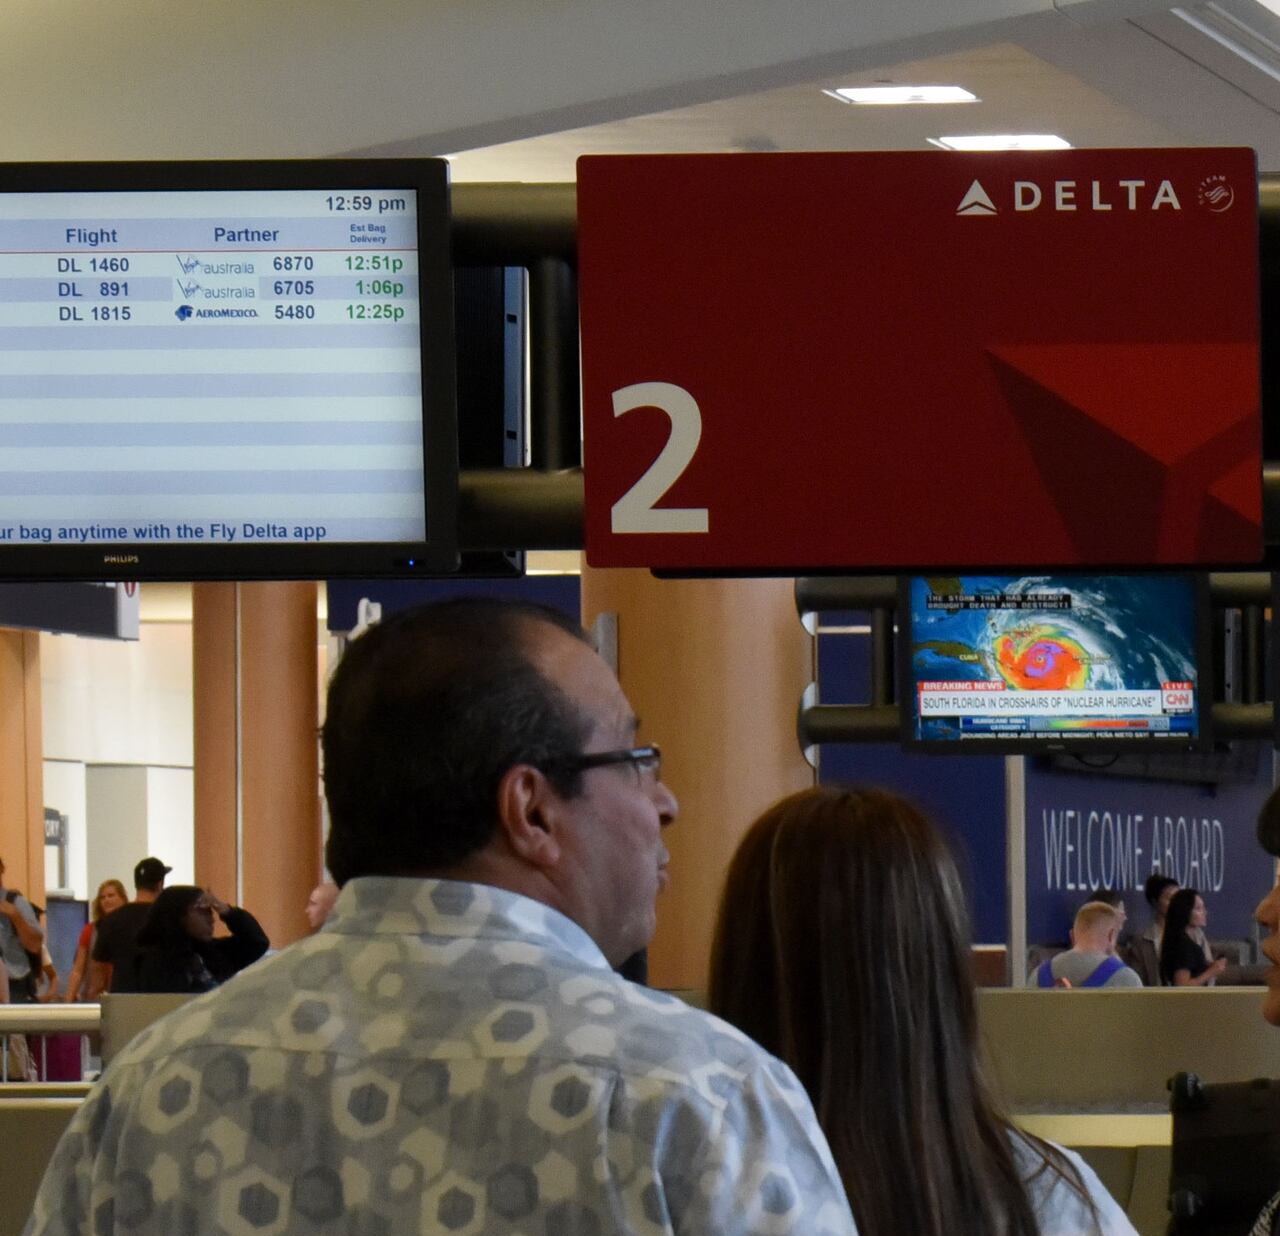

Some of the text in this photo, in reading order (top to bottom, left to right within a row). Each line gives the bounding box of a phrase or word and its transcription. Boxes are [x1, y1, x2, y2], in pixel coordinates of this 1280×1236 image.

[1014, 179, 1181, 211] DELTA
[326, 196, 406, 214] 12:59 pm
[214, 228, 280, 242] Partner
[350, 224, 386, 234] Est Bag
[66, 228, 118, 246] Flight
[350, 234, 387, 244] Delivery
[57, 258, 130, 272] DL 1460
[204, 263, 254, 274] australia
[273, 256, 314, 270] 6870
[345, 256, 403, 274] 12:51p
[58, 282, 129, 296] DL 891
[204, 288, 255, 298] australia
[274, 280, 314, 295] 6705
[356, 280, 404, 298] 1:06p
[59, 306, 131, 320] DL 1815
[274, 305, 315, 319] 5480
[346, 304, 404, 322] 12:25p
[610, 381, 710, 534] 2
[20, 524, 52, 542] bag
[58, 524, 128, 542] anytime
[133, 524, 170, 538] with
[176, 524, 204, 538] the
[210, 523, 236, 542] Fly
[242, 522, 287, 538] Delta
[293, 526, 326, 542] app
[104, 556, 140, 564] PHILIPS
[924, 682, 1002, 690] BREAKING NEWS
[924, 697, 950, 709] SOUTH
[952, 697, 986, 708] FLORIDA
[999, 697, 1048, 708] CROSSHAIRS
[1042, 808, 1225, 892] WELCOME ABOARD
